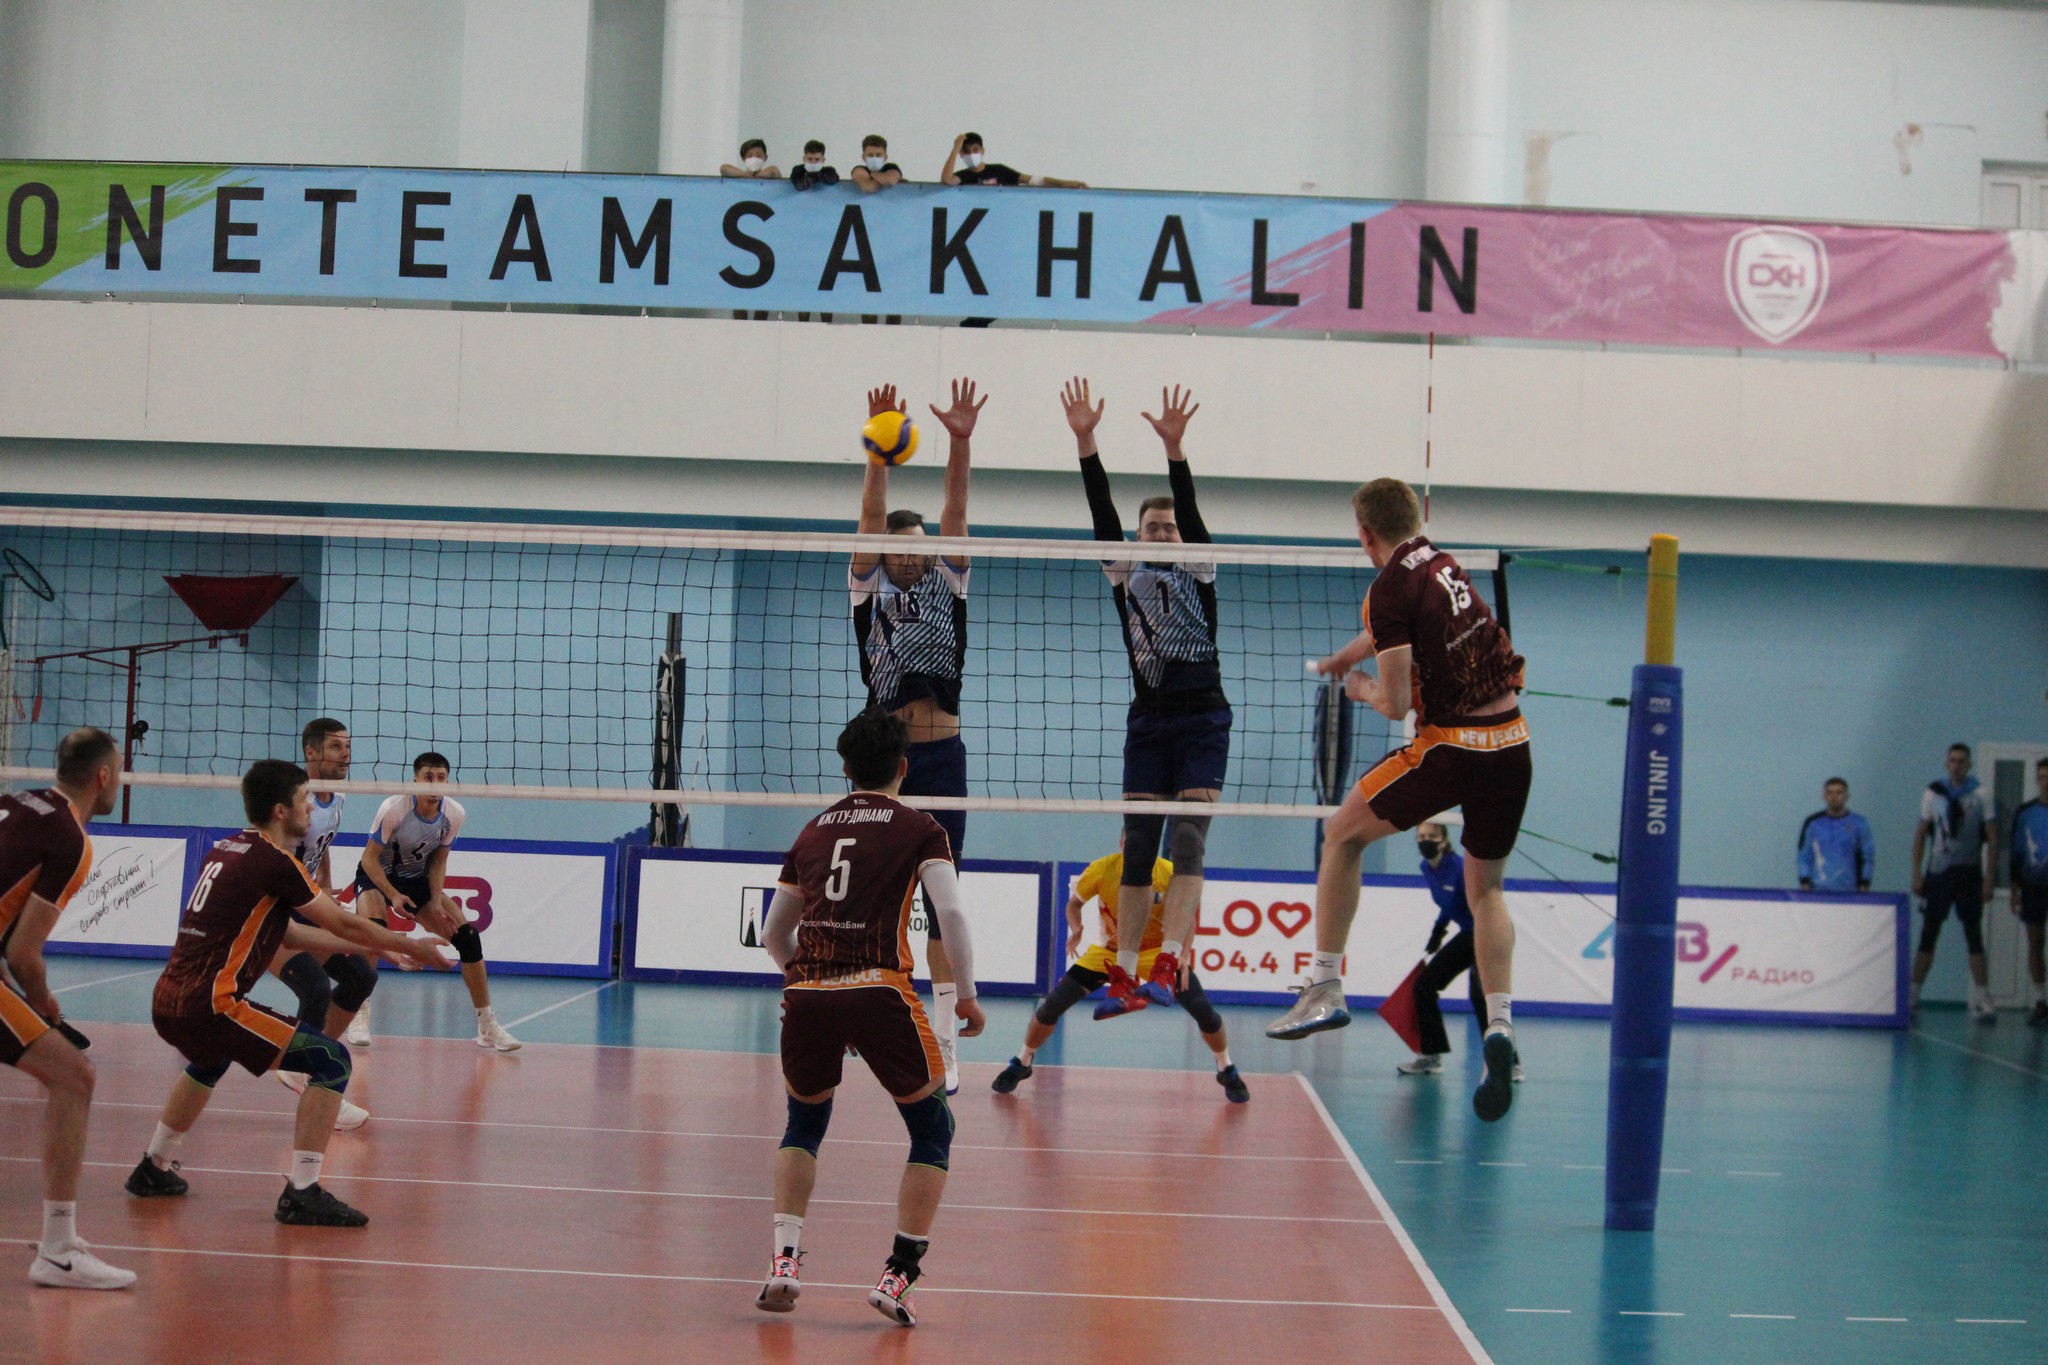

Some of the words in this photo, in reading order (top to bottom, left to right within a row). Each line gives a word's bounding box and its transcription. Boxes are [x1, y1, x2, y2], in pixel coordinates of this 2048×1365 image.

[1155, 580, 1170, 614] 1
[1436, 566, 1472, 616] 15
[1647, 750, 1669, 835] JINLING
[186, 861, 223, 913] 16
[825, 838, 856, 901] 5
[1732, 966, 1815, 985] РАДИО
